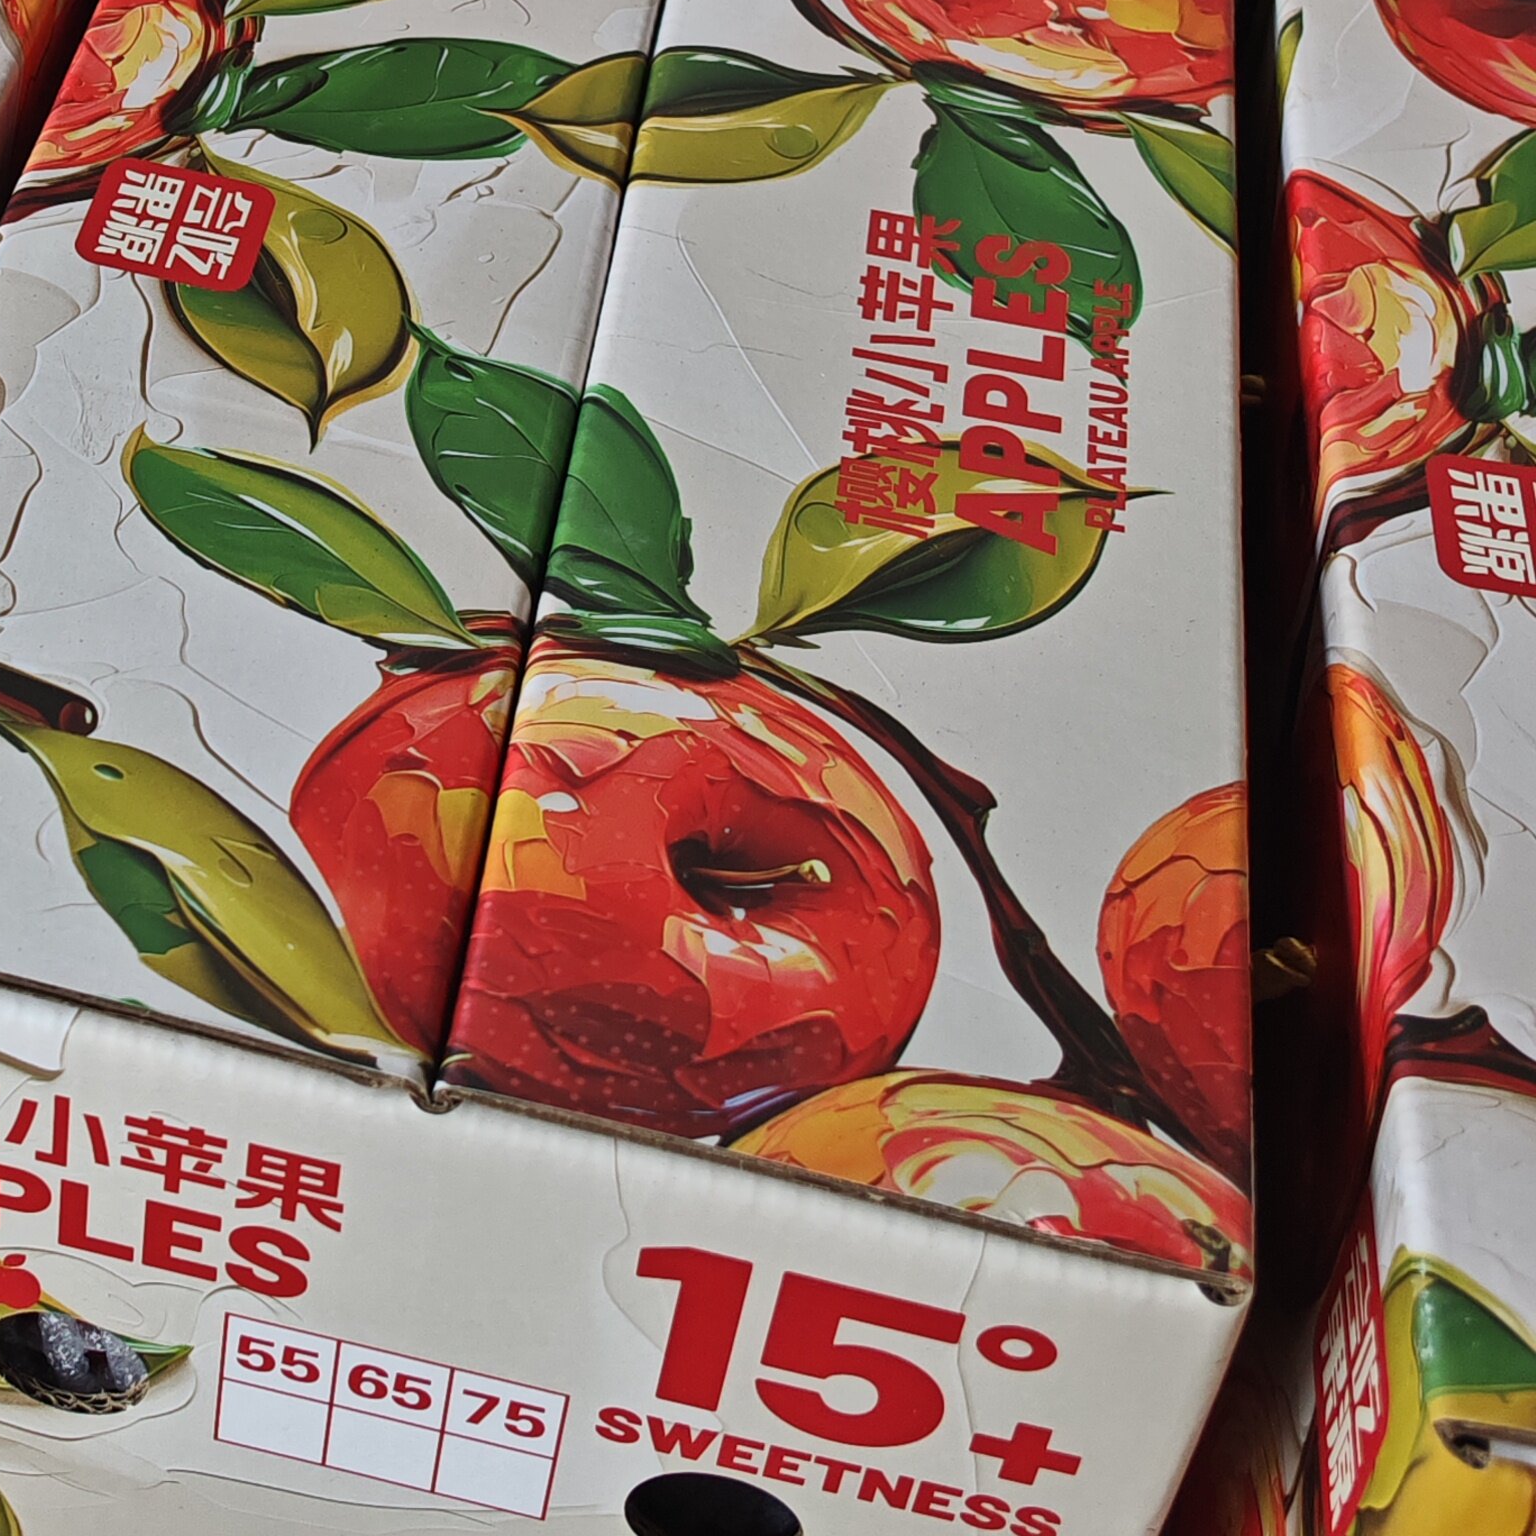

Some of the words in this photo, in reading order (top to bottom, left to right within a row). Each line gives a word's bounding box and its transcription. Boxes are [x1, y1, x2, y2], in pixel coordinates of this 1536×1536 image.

[834, 209, 962, 540] 樱桃小苹果
[955, 233, 1072, 556] APPLES
[1090, 279, 1133, 380] APPLE
[1084, 381, 1130, 534] PLATEAU
[236, 1335, 321, 1384] 55
[348, 1366, 432, 1413] 65
[462, 1388, 547, 1440] 75
[595, 1407, 1062, 1536] SWEETNESS
